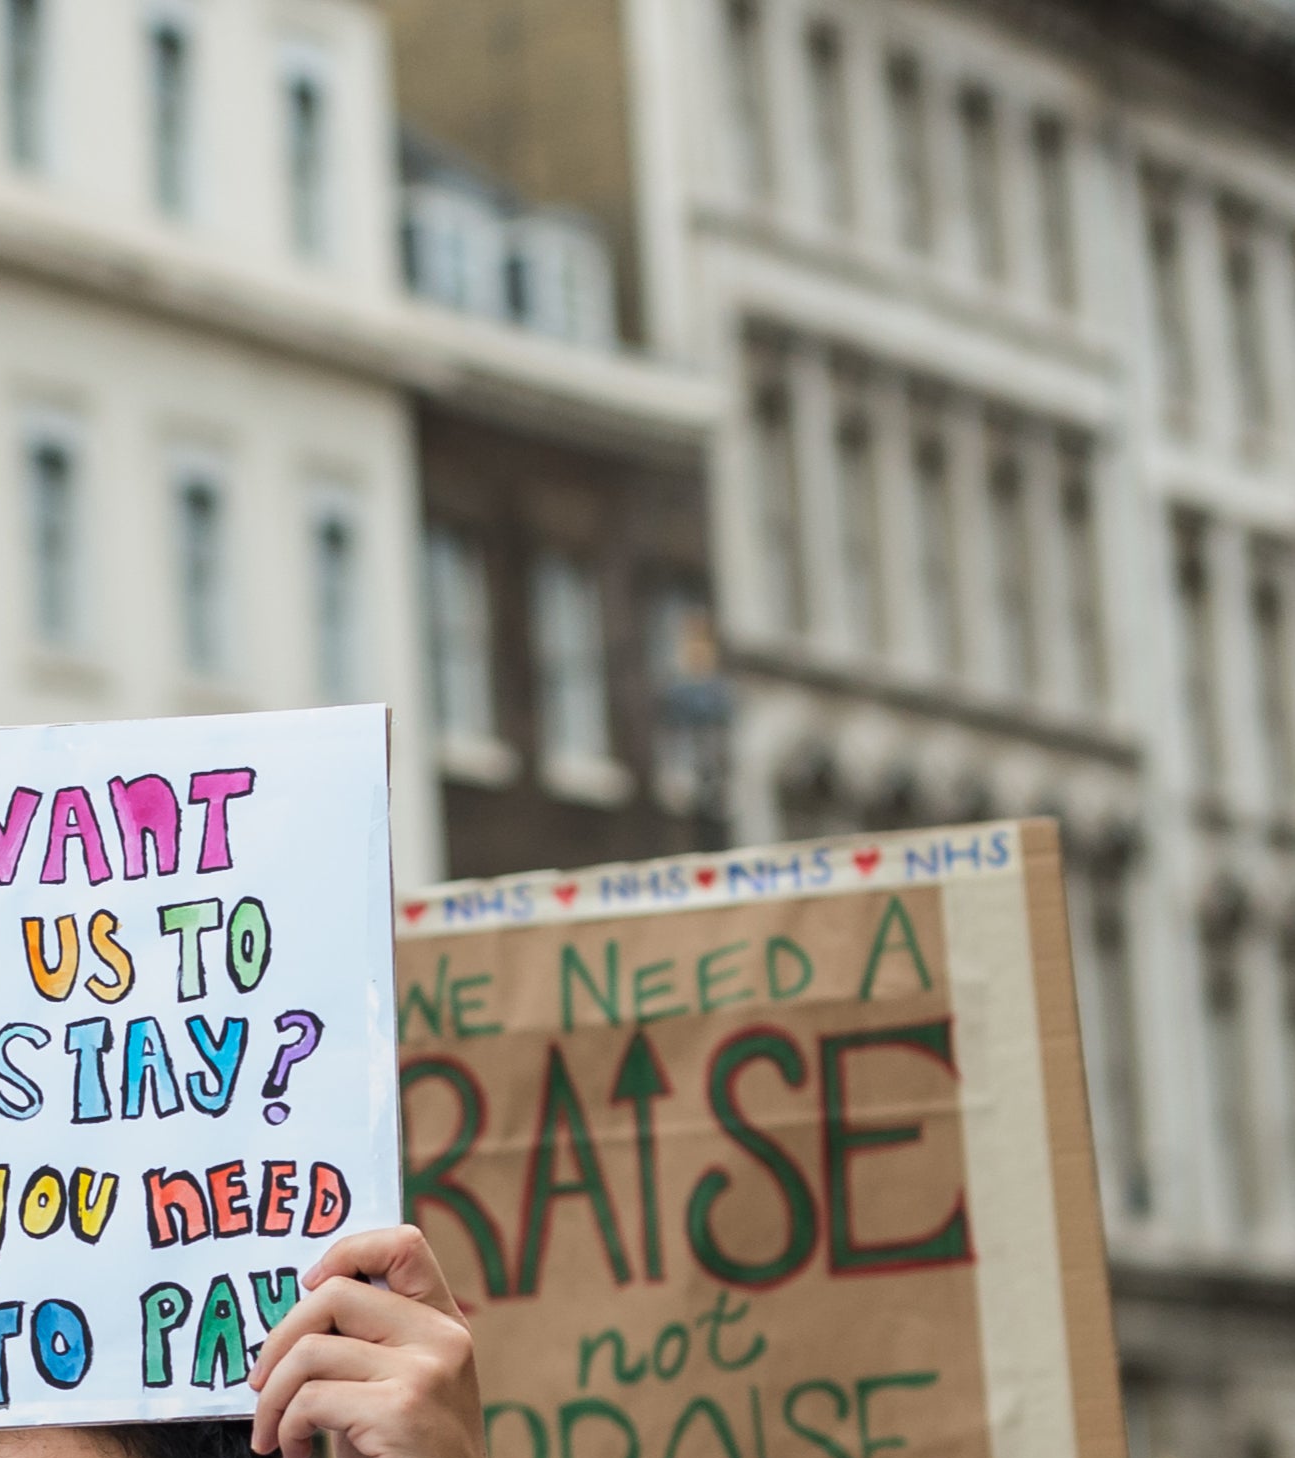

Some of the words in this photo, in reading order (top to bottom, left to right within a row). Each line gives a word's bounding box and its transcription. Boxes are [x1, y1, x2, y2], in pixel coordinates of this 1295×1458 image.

[442, 882, 535, 925] NHS
[598, 866, 691, 908] NHS
[727, 847, 834, 893] NHS
[904, 830, 1009, 878] NHS
[21, 908, 135, 1002] US
[158, 896, 272, 1003] TO
[395, 954, 503, 1044] WE
[560, 936, 814, 1033] NEED
[860, 896, 932, 1003] A
[399, 1018, 976, 1312] RAISE
[577, 1291, 767, 1390] not
